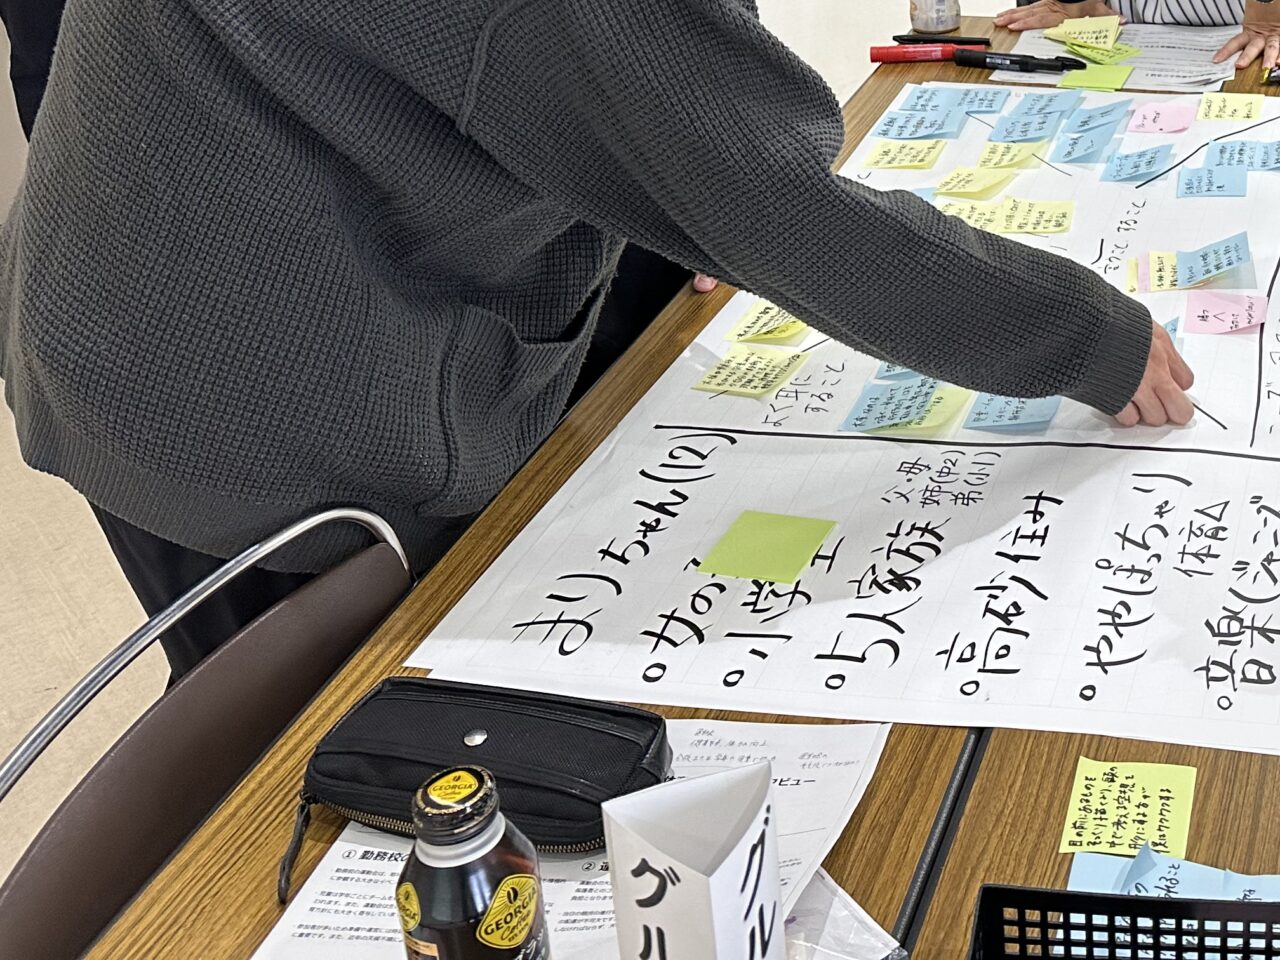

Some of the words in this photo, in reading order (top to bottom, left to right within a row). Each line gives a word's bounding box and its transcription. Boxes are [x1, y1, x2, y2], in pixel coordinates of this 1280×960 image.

[761, 374, 812, 427] よく耳に
[803, 361, 846, 414] すること
[921, 450, 966, 509] 姉(中2)
[951, 450, 1002, 509] 弟(小1)
[815, 517, 951, 670] 5人家族
[936, 490, 1064, 674] 高砂住み
[1085, 472, 1193, 675] ややぽっちゃり
[432, 783, 476, 792] GEORGIA
[1069, 775, 1098, 849] 目の前にあるものを
[483, 886, 537, 936] GEORGIA
